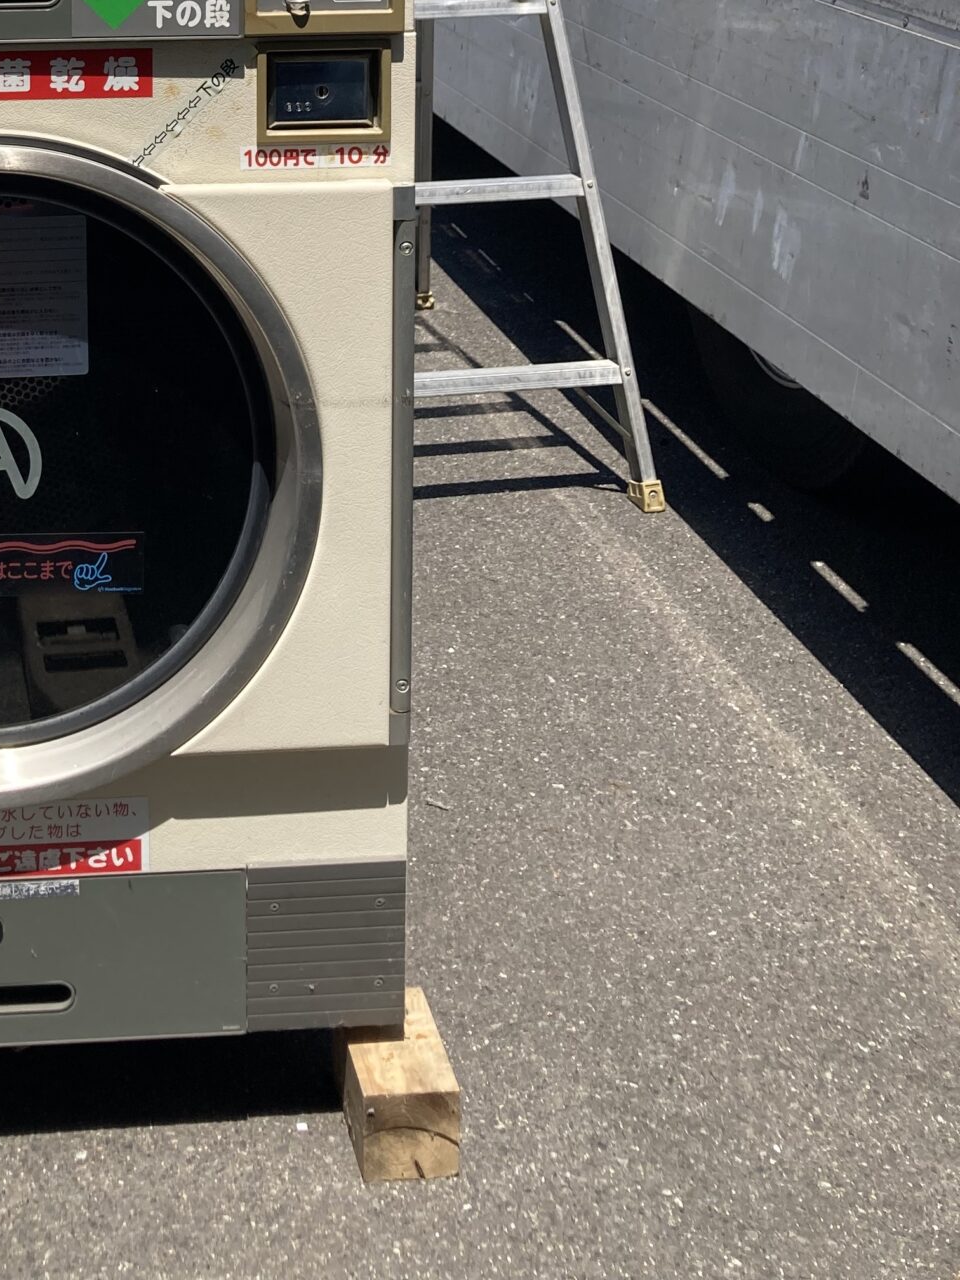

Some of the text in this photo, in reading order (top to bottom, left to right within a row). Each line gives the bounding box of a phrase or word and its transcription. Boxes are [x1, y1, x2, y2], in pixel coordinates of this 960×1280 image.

[147, 0, 231, 29] 下の段
[196, 58, 240, 97] 下の段
[244, 144, 389, 168] 100円で 10 分
